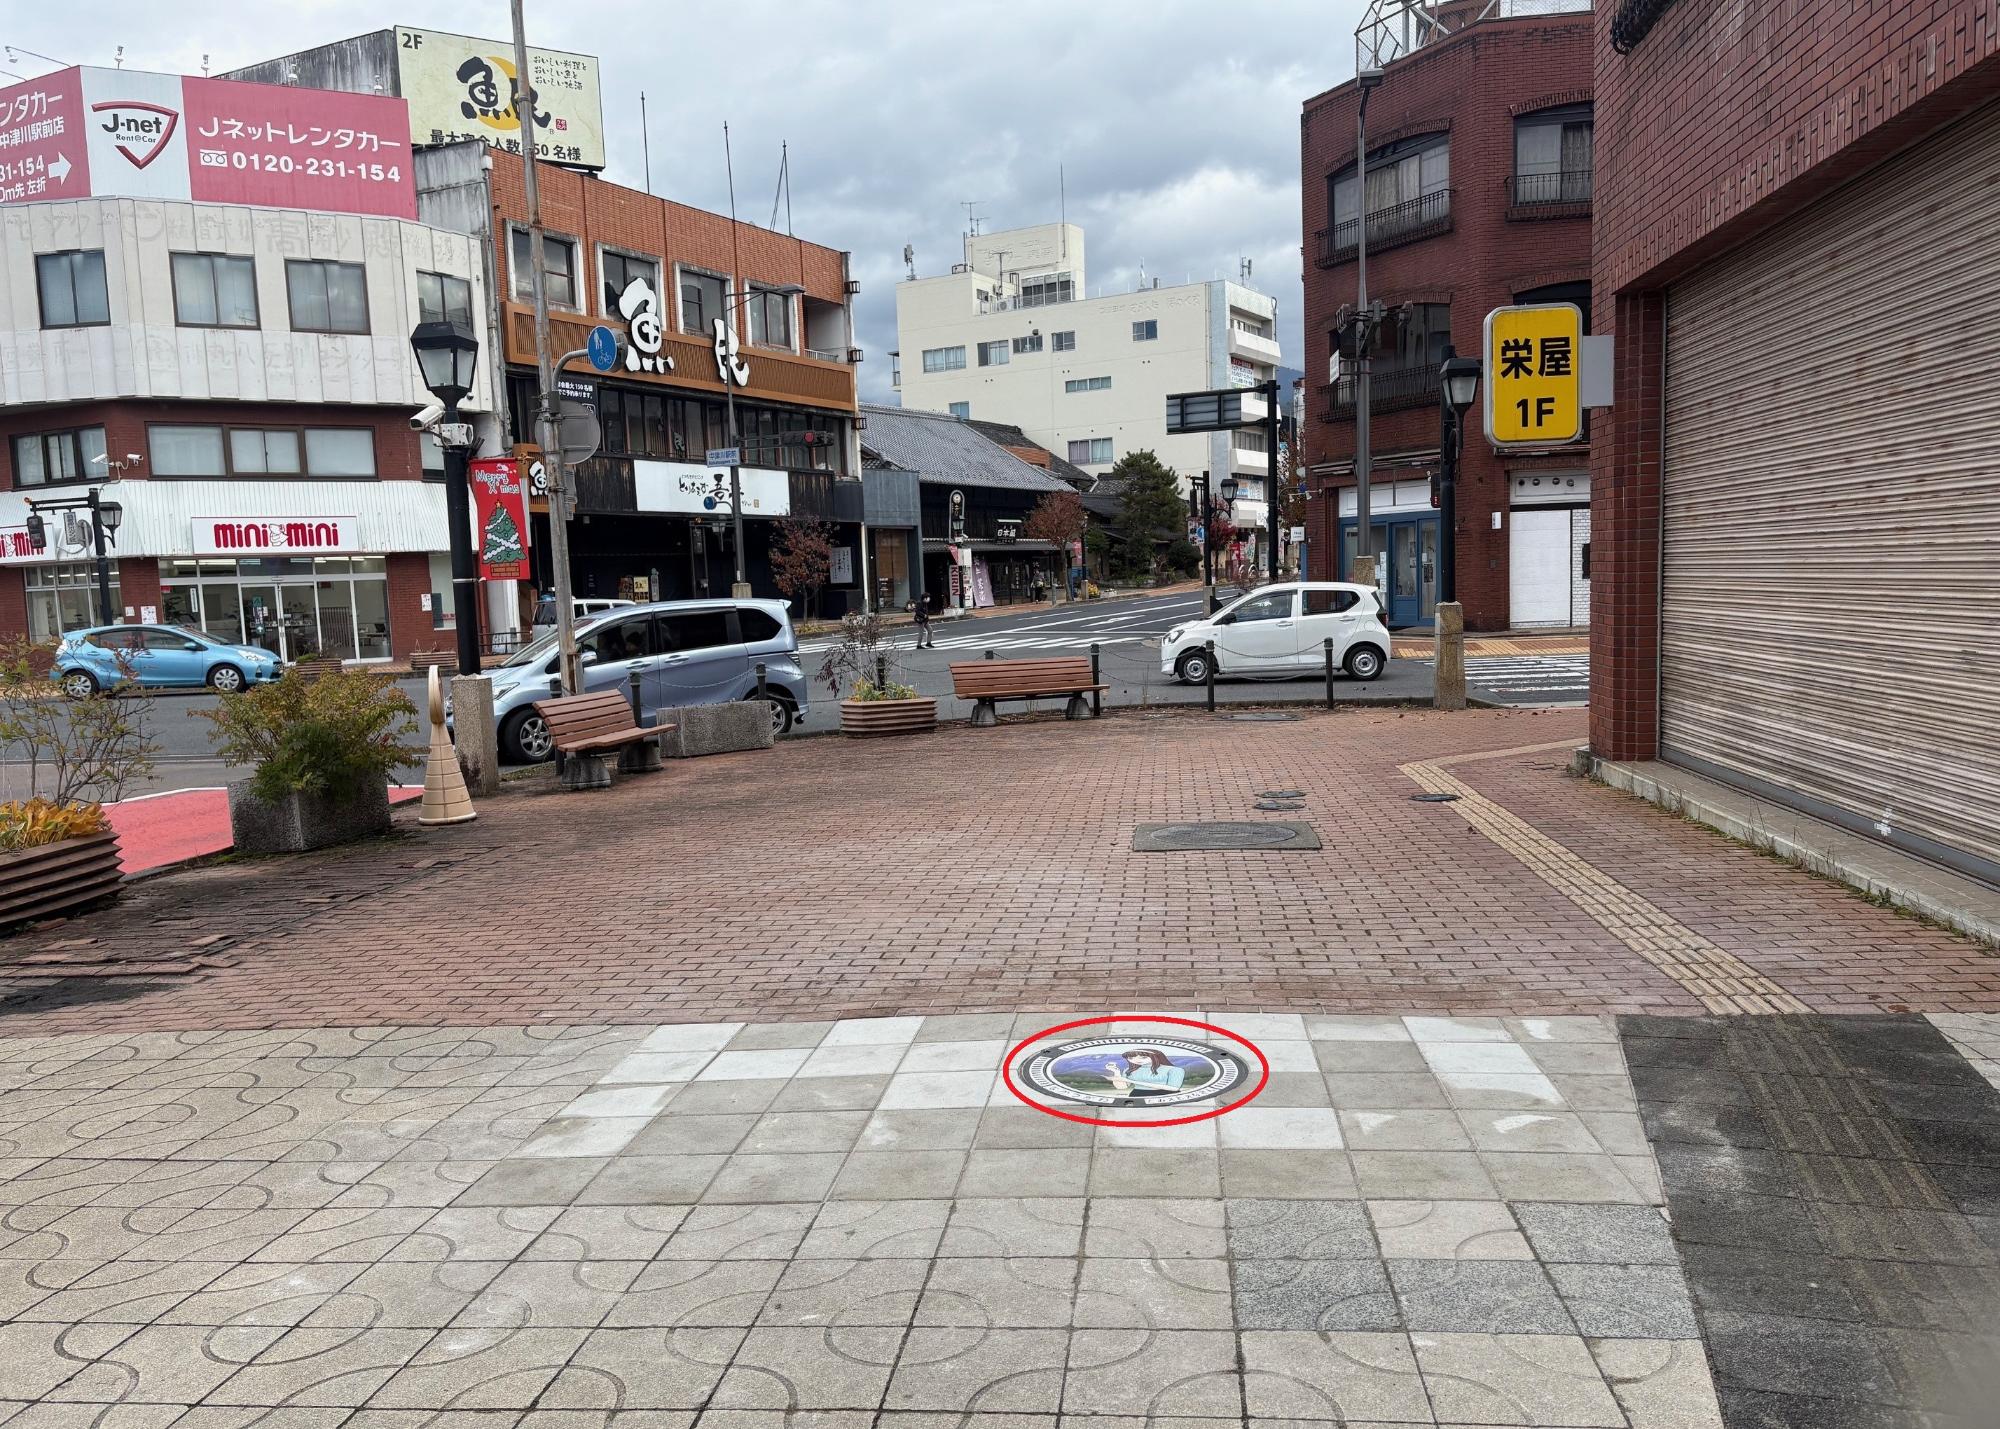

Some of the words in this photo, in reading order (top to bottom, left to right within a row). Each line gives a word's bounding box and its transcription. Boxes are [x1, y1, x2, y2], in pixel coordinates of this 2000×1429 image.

[402, 33, 422, 49] 2F
[0, 116, 65, 149] 中津川駅前店
[101, 113, 162, 133] J-net
[199, 117, 401, 152] Jネットレンタカー
[232, 151, 401, 182] 0120-231-154
[1501, 337, 1571, 379] 栄屋
[1516, 397, 1555, 427] 1F
[475, 470, 509, 485] Merry
[487, 481, 520, 495] X'mas
[213, 523, 269, 548] mini
[286, 522, 339, 547] mini
